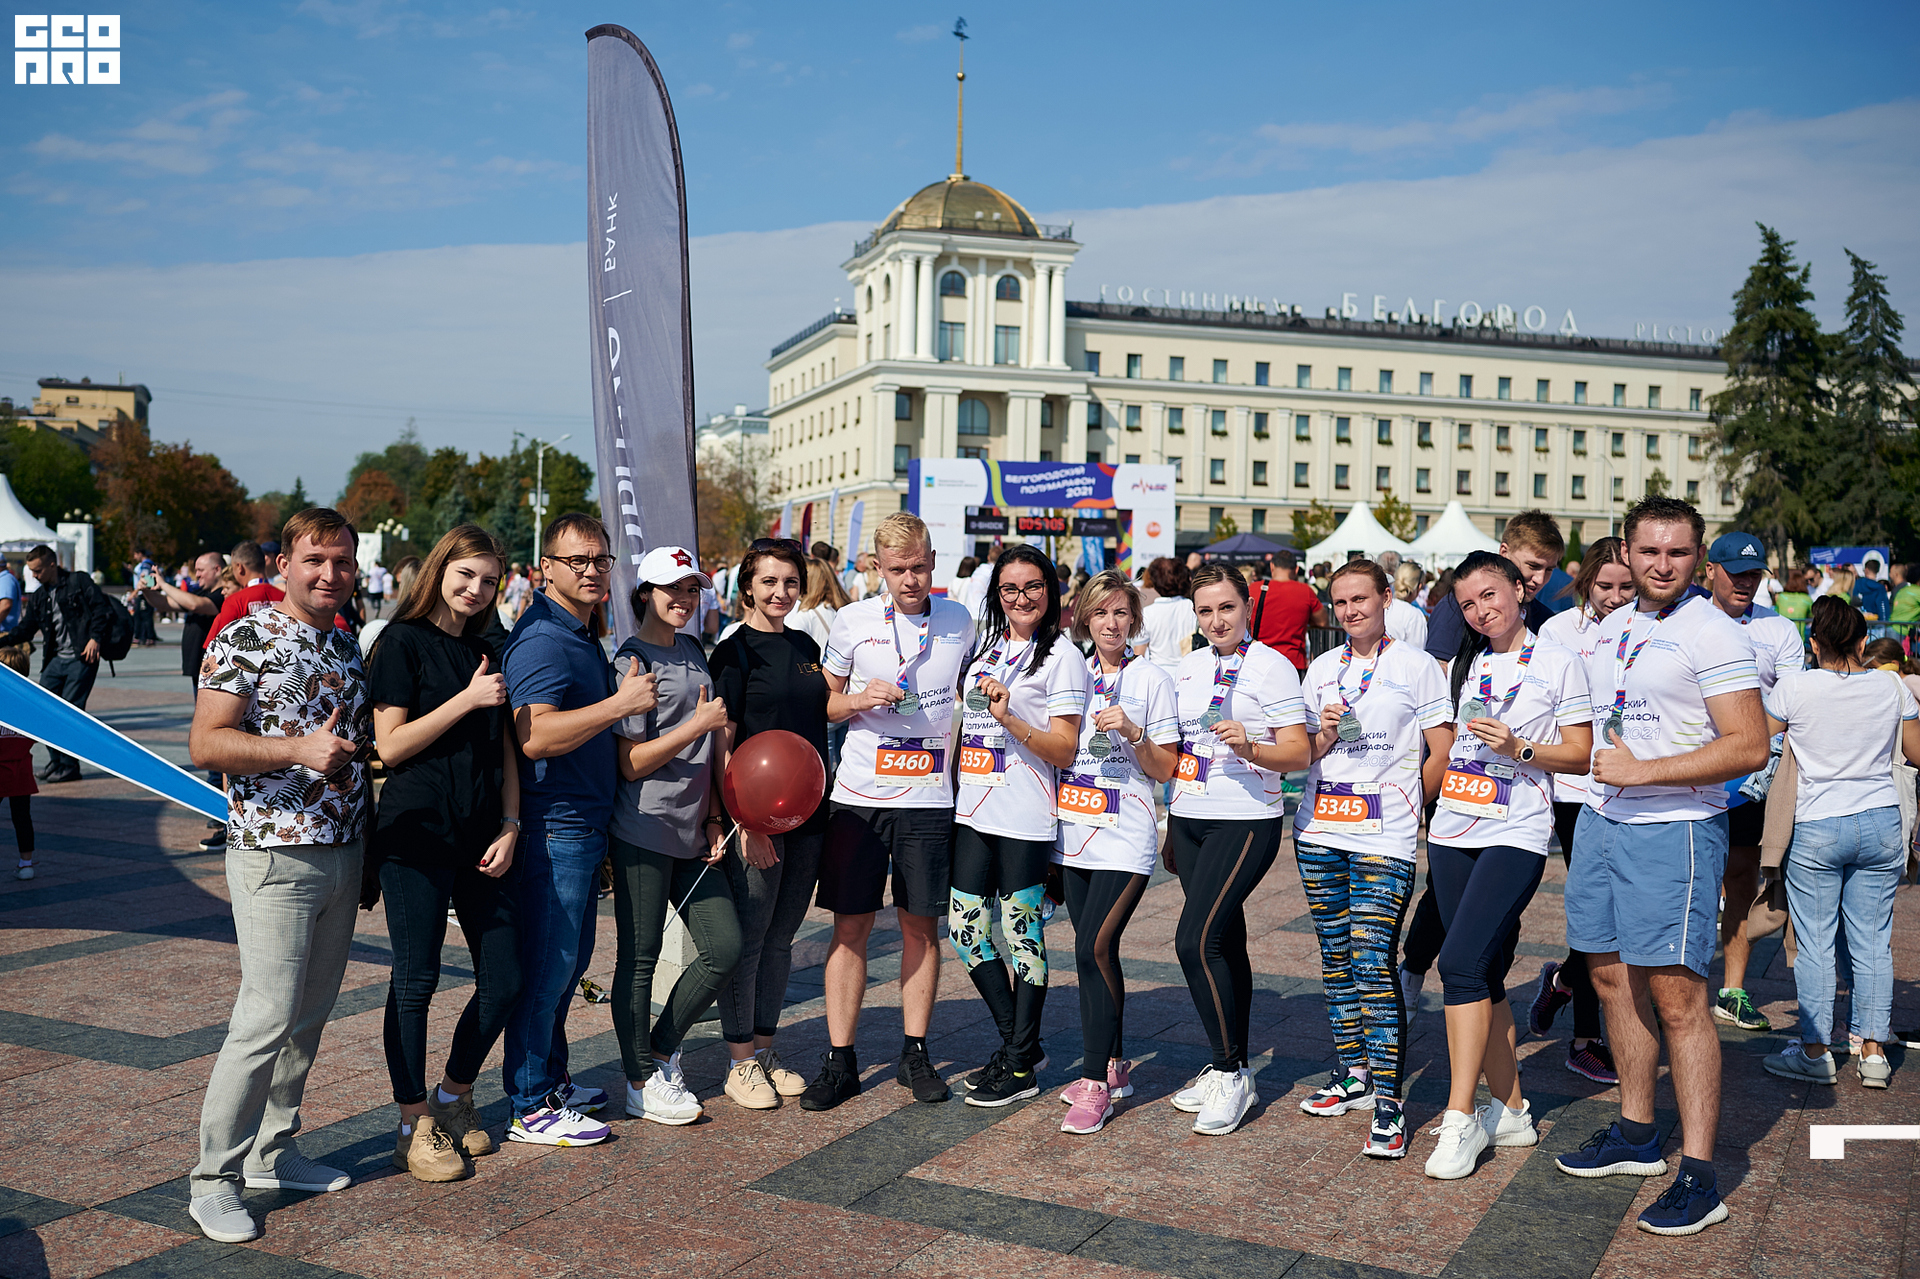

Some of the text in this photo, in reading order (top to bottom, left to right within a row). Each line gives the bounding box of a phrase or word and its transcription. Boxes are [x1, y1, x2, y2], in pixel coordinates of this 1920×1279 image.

[604, 192, 618, 272] БАНК
[1341, 292, 1579, 336] БЕЛГОРОД
[1005, 465, 1086, 484] БЕЛГОРОДСКИЙ
[1065, 486, 1093, 498] 2021
[1622, 726, 1661, 740] 2021
[881, 753, 930, 770] 5460
[962, 750, 991, 768] 5357
[1179, 757, 1196, 775] 68
[1358, 755, 1395, 767] 2021
[1445, 774, 1493, 797] 5349
[1061, 787, 1103, 809] 5356
[1318, 798, 1363, 816] 5345
